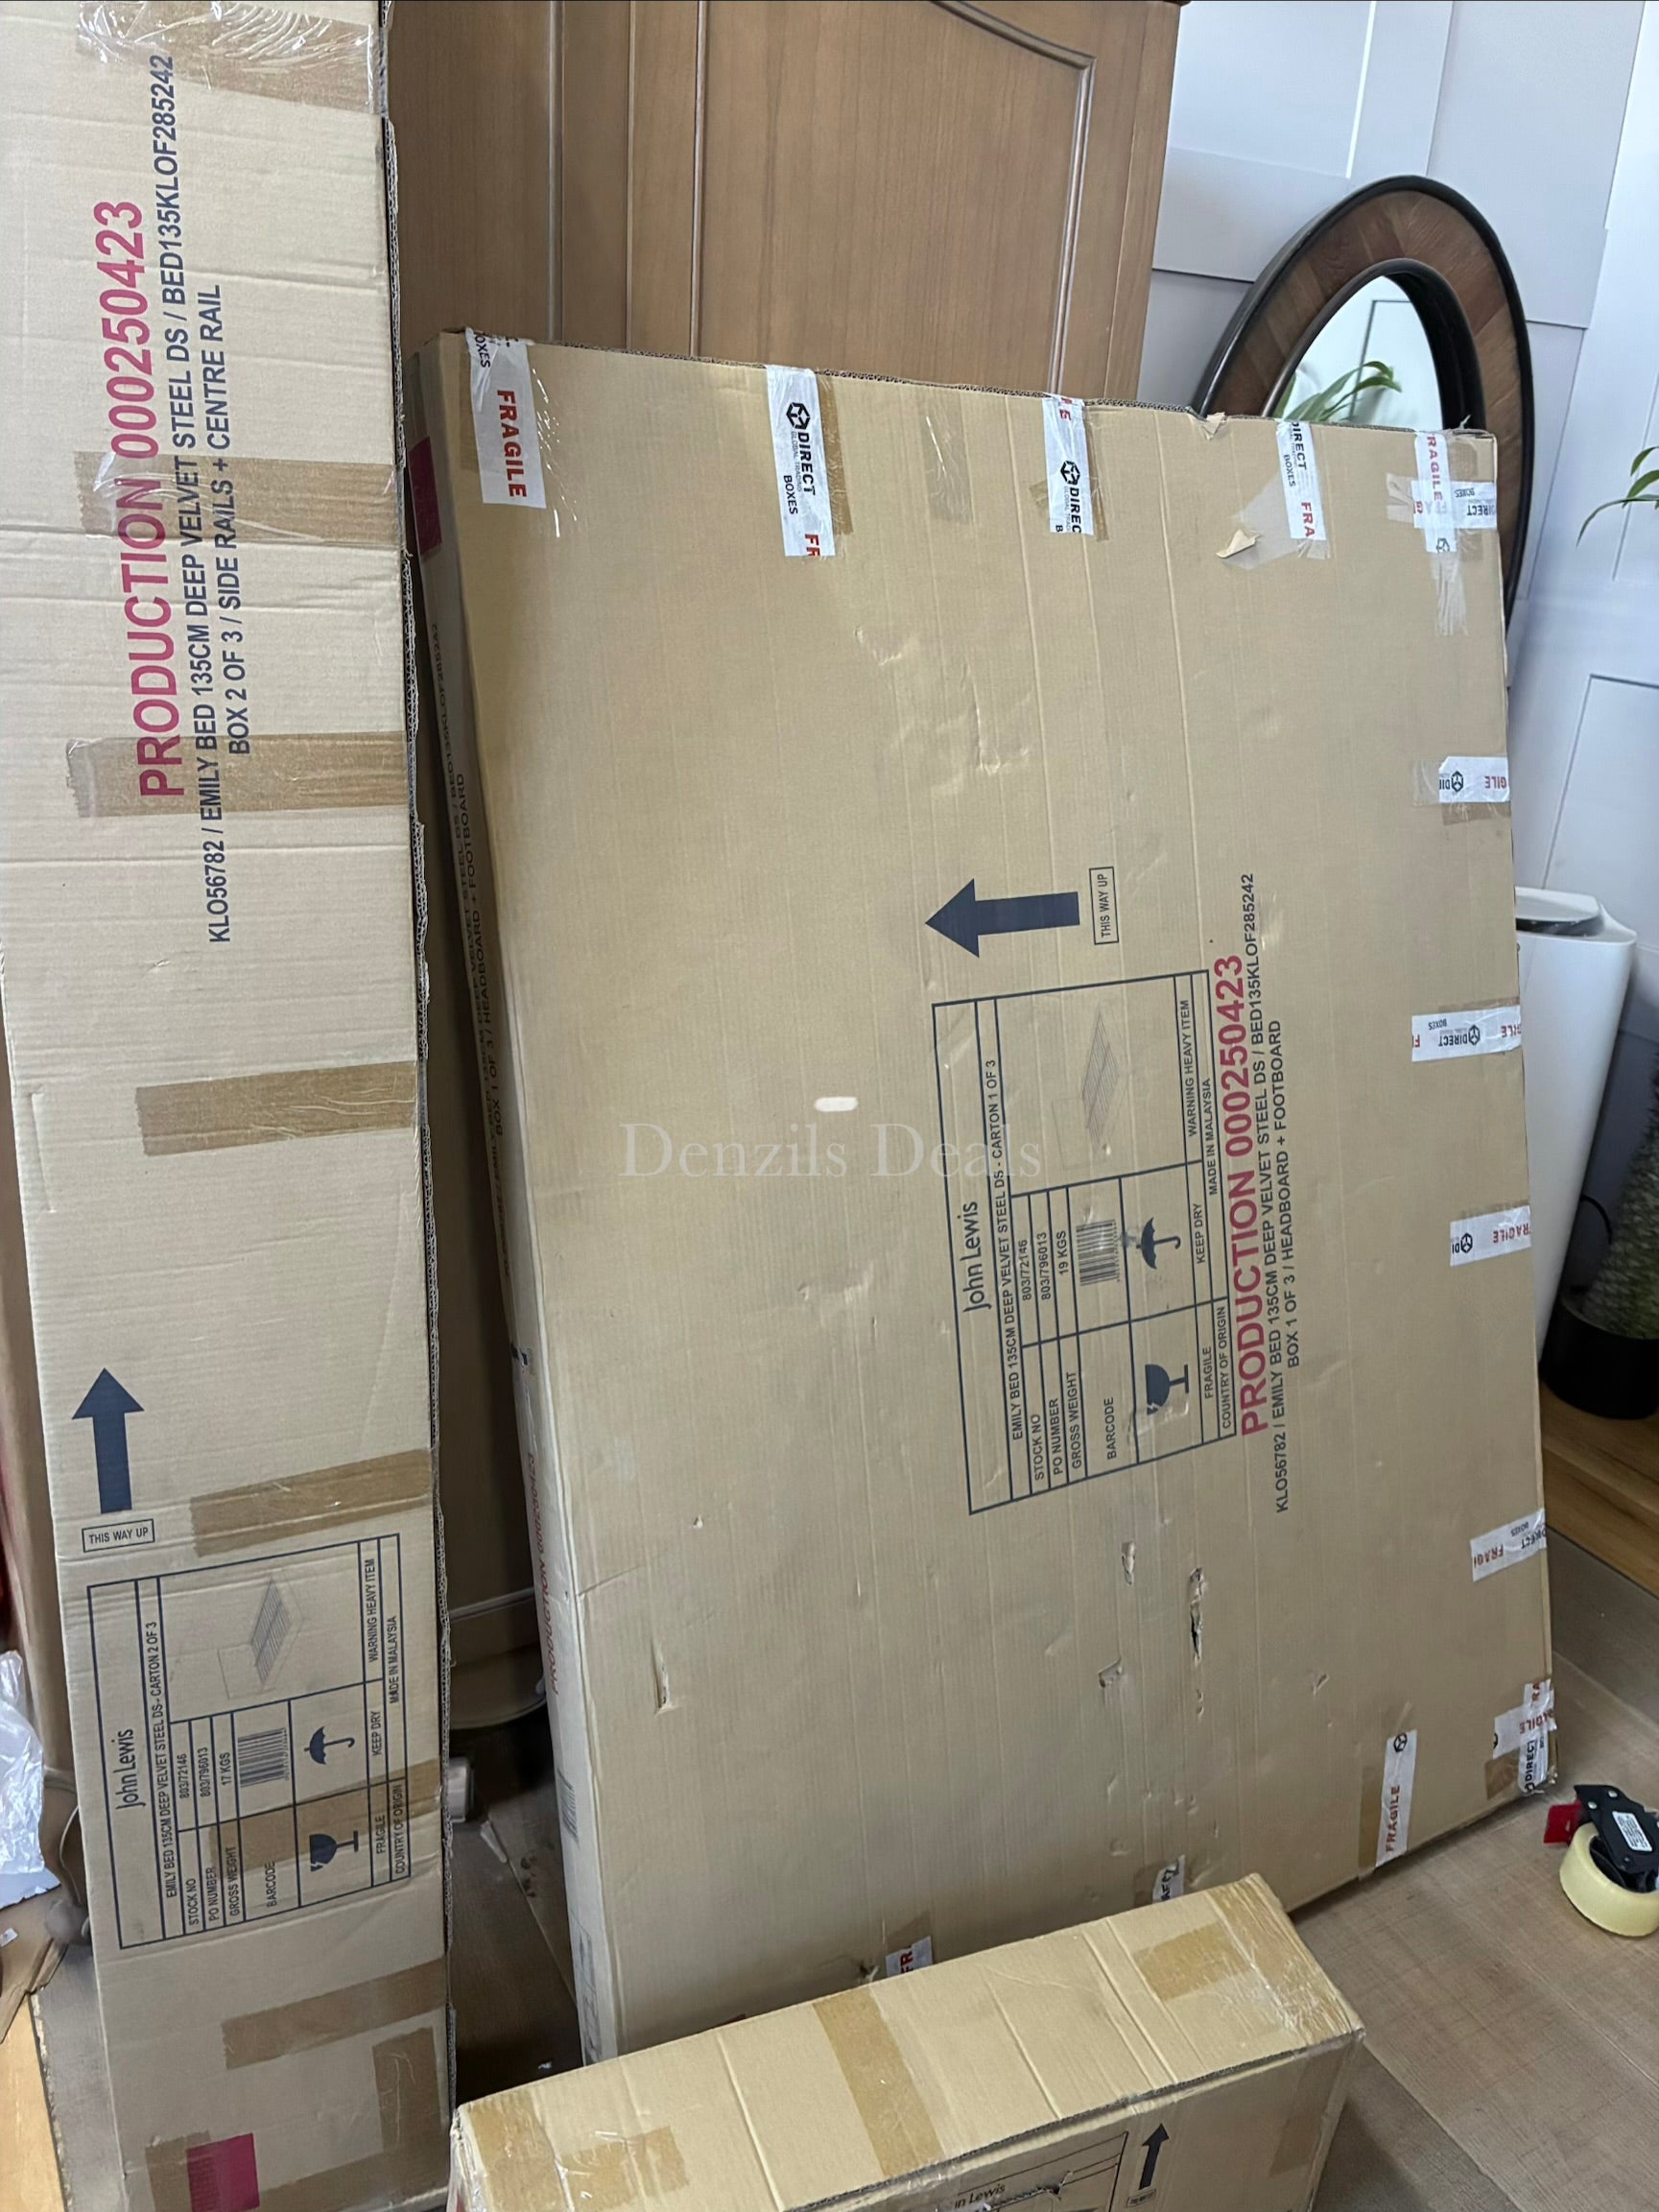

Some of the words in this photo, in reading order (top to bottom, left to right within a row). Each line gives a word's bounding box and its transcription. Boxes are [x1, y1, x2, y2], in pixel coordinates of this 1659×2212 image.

[150, 55, 186, 305] BED135KLOF285242
[94, 202, 158, 459] 000250423
[198, 284, 224, 342] RAIL
[164, 328, 190, 362] DS
[474, 332, 490, 368] OXES
[169, 370, 196, 449] STEEL
[201, 350, 231, 450] CENTRE
[496, 389, 528, 498] FRAGILE
[213, 458, 228, 471] +
[798, 433, 816, 495] DIRECT
[1284, 455, 1295, 487] BOXES
[1427, 434, 1442, 501] RAGILE
[175, 456, 202, 547] VELVET
[784, 475, 797, 514] BOXES
[210, 479, 238, 550] RAILS
[181, 554, 209, 616] DEEP
[216, 559, 242, 610] SIDE
[114, 478, 184, 797] PRODUCTION
[219, 616, 242, 625] /
[221, 630, 243, 642] 3
[186, 624, 213, 696] 135CM
[223, 651, 246, 681] OF
[225, 689, 247, 701] 2
[193, 704, 218, 750] BED
[226, 707, 250, 754] BOX
[197, 756, 223, 821] EMILY
[457, 773, 476, 889] FOOTBOARD
[203, 840, 230, 942] KLO56782
[1098, 873, 1107, 888] UP
[1099, 892, 1110, 912] WAY
[1101, 915, 1111, 938] THIS
[472, 910, 491, 1024] HEADBOARD
[1241, 873, 1265, 1045] BED135KLOF285242
[1180, 1000, 1192, 1030] ITEM
[1429, 1018, 1446, 1031] BOXES
[486, 1039, 494, 1049] 3
[1181, 1033, 1194, 1074] HEAVY
[1214, 955, 1253, 1157] 000250423
[1438, 1034, 1467, 1046] DIRECT
[487, 1055, 498, 1079] OF
[986, 1071, 997, 1089] OF
[1252, 1059, 1267, 1083] DS
[1268, 1020, 1287, 1130] FOOTBOARD
[492, 1100, 503, 1136] BOX
[1184, 1078, 1197, 1137] WARNING
[1201, 1079, 1215, 1141] MALAYSIA
[1255, 1088, 1270, 1144] STEEL
[988, 1104, 1003, 1159] CARTON
[1206, 1144, 1216, 1156] IN
[994, 1170, 1005, 1188] DS
[1206, 1159, 1219, 1195] MADE
[1257, 1151, 1273, 1215] VELVET
[996, 1192, 1007, 1233] STEEL
[1193, 1203, 1204, 1227] DRY
[1276, 1151, 1293, 1260] HEADBOARD
[957, 1201, 984, 1261] Lewis
[1056, 1230, 1067, 1258] KGS
[1195, 1230, 1205, 1264] KEEP
[1262, 1220, 1277, 1266] DEEP
[1493, 1224, 1530, 1243] RAGILE
[999, 1237, 1012, 1286] VELVET
[1018, 1240, 1031, 1301] 803/72146
[1036, 1232, 1052, 1300] 803/796013
[1058, 1261, 1069, 1274] 19
[1283, 1274, 1294, 1283] 3
[962, 1263, 992, 1313] John
[1227, 1170, 1268, 1436] PRODUCTION
[1265, 1271, 1280, 1324] 135CM
[1284, 1291, 1296, 1312] OF
[1004, 1290, 1015, 1324] DEEP
[1216, 1306, 1228, 1348] ORIGIN
[1006, 1327, 1018, 1368] 135CM
[1220, 1352, 1229, 1368] OF
[1268, 1329, 1282, 1365] BED
[1286, 1331, 1299, 1368] BOX
[1009, 1372, 1021, 1398] BED
[1202, 1346, 1214, 1399] FRAGILE
[1066, 1371, 1078, 1422] WEIGHT
[1220, 1371, 1232, 1429] COUNTRY
[1270, 1370, 1286, 1418] EMILY
[1011, 1402, 1023, 1439] EMILY
[1031, 1415, 1041, 1433] NO
[1049, 1398, 1061, 1453] NUMBER
[1103, 1397, 1117, 1460] BARCODE
[1031, 1437, 1045, 1481] STOCK
[1069, 1424, 1082, 1469] GROSS
[1053, 1457, 1063, 1476] PO
[1273, 1432, 1290, 1513] KLO56782
[89, 1533, 109, 1544] THIS
[113, 1530, 132, 1540] WAY
[136, 1527, 148, 1537] UP
[365, 1558, 375, 1582] ITEM
[367, 1584, 377, 1615] HEAVY
[146, 1631, 157, 1644] OF
[367, 1617, 379, 1662] WARNING
[387, 1616, 398, 1664] MALAYSIA
[538, 1558, 558, 1695] PRODUCTION
[148, 1654, 161, 1697] CARTON
[389, 1666, 398, 1676] IN
[389, 1677, 399, 1703] MADE
[152, 1704, 163, 1717] DS
[370, 1710, 381, 1729] DRY
[111, 1729, 136, 1773] Lewis
[154, 1720, 166, 1750] STEEL
[371, 1731, 382, 1756] KEEP
[155, 1753, 168, 1789] VELVET
[220, 1752, 230, 1772] KGS
[222, 1776, 231, 1785] 17
[115, 1773, 146, 1809] John
[158, 1792, 171, 1816] DEEP
[391, 1784, 403, 1816] ORIGIN
[160, 1819, 173, 1847] 135CM
[375, 1816, 387, 1854] FRAGILE
[393, 1819, 404, 1829] OF
[1386, 1785, 1400, 1852] FRAGILE
[164, 1850, 175, 1869] BED
[225, 1846, 237, 1882] WEIGHT
[393, 1832, 405, 1873] COUNTRY
[165, 1872, 178, 1898] EMILY
[186, 1878, 197, 1892] NO
[205, 1867, 217, 1905] NUMBER
[228, 1883, 240, 1916] GROSS
[265, 1861, 277, 1908] BARCODE
[187, 1894, 200, 1926] STOCK
[208, 1908, 219, 1921] PO
[969, 2183, 1006, 2204] Lewis
